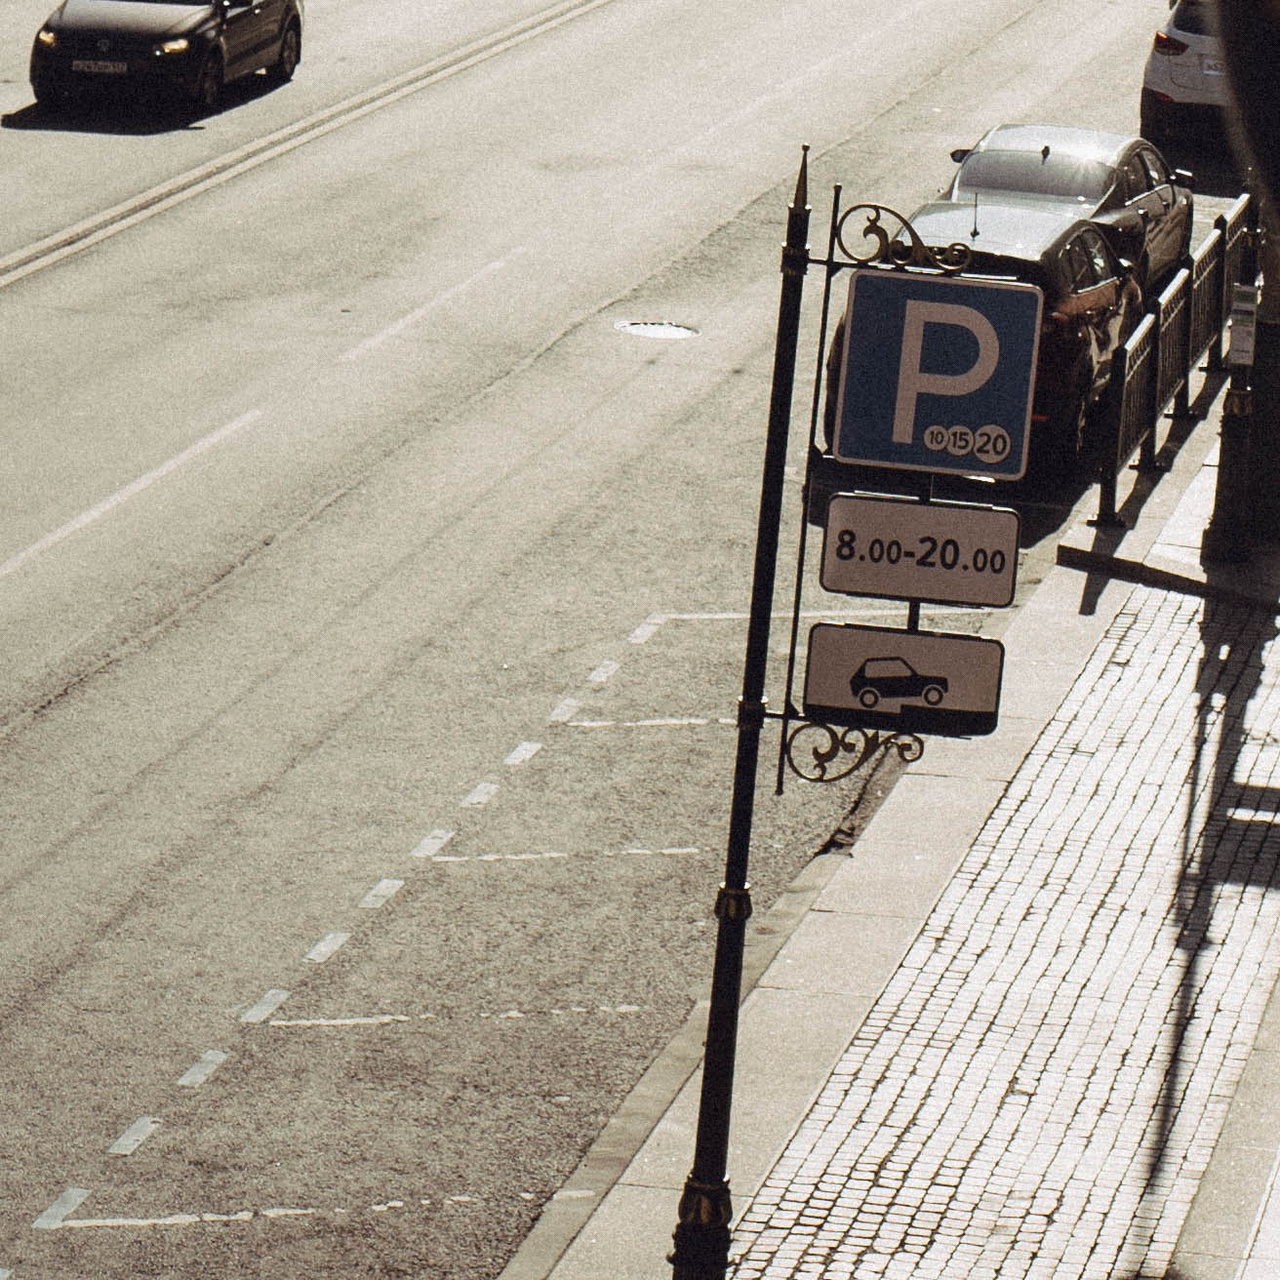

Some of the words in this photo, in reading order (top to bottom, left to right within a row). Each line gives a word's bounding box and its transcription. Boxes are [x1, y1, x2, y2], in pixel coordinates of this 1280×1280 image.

[892, 300, 1000, 444] P
[929, 430, 945, 445] 10
[951, 430, 970, 450] 15
[976, 432, 1007, 456] 20
[836, 529, 1006, 574] 8.00-20.00
